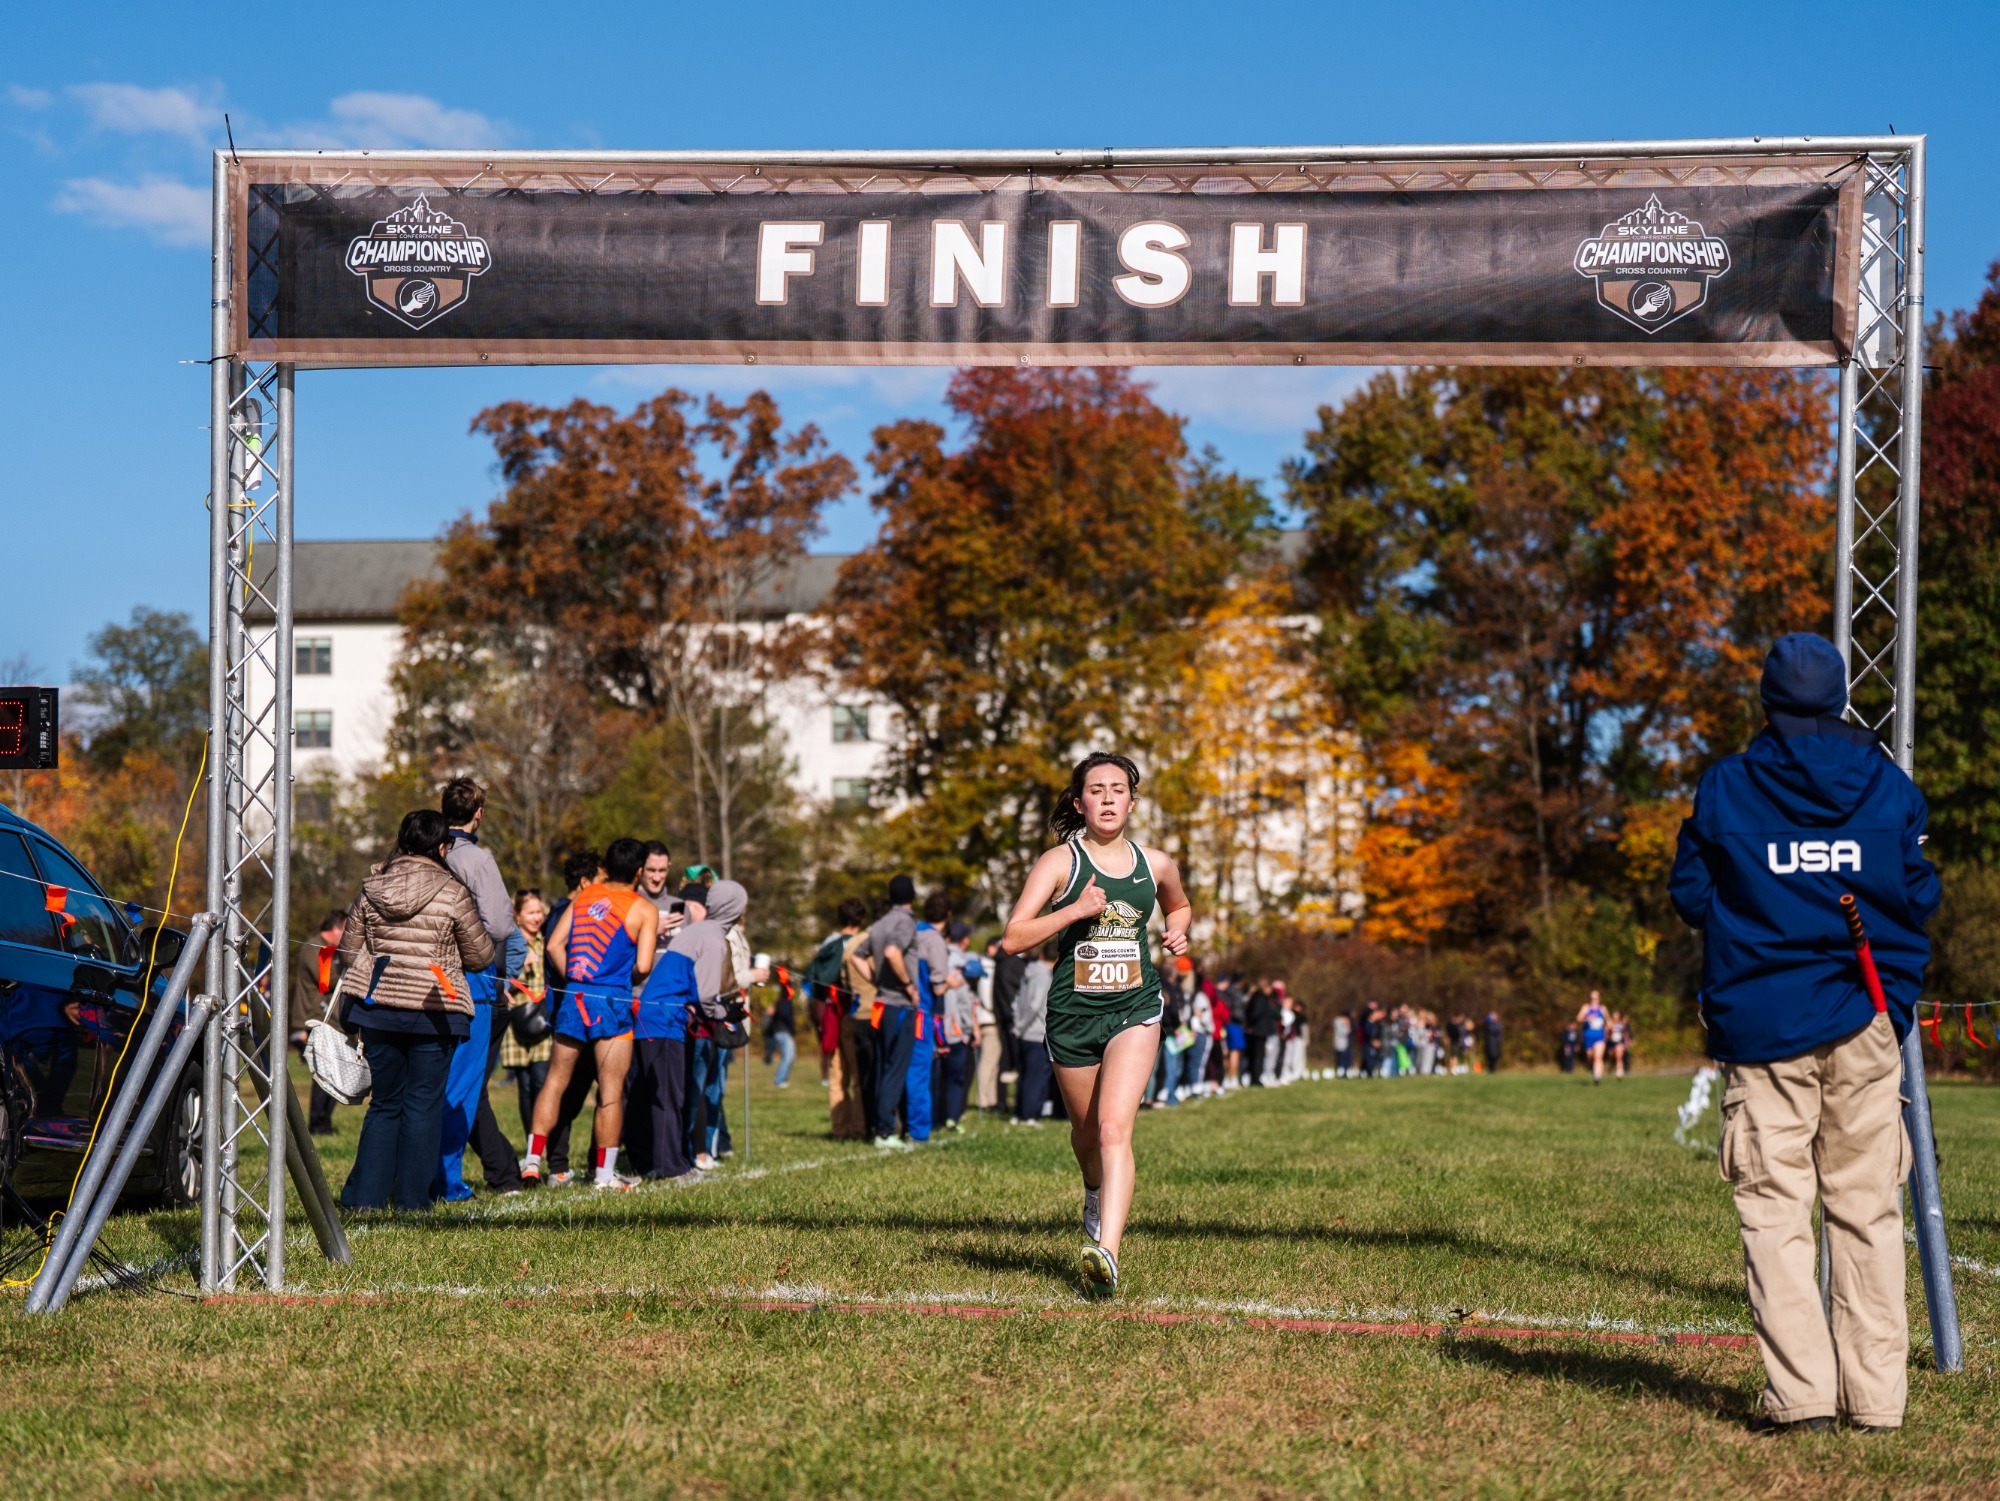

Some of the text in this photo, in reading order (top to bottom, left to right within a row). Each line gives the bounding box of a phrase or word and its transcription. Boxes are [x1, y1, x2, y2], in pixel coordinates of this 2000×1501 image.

[386, 225, 453, 234] SKYLINE
[1618, 225, 1689, 235] SKYLINE
[351, 240, 485, 266] CHAMPIONSHIP
[1579, 241, 1725, 268] CHAMPIONSHIP
[413, 265, 451, 273] COUNTRY
[755, 220, 1307, 308] FINISH
[1615, 267, 1689, 275] CROSS COUNTRY
[1767, 840, 1862, 875] USA
[1088, 962, 1128, 983] 200
